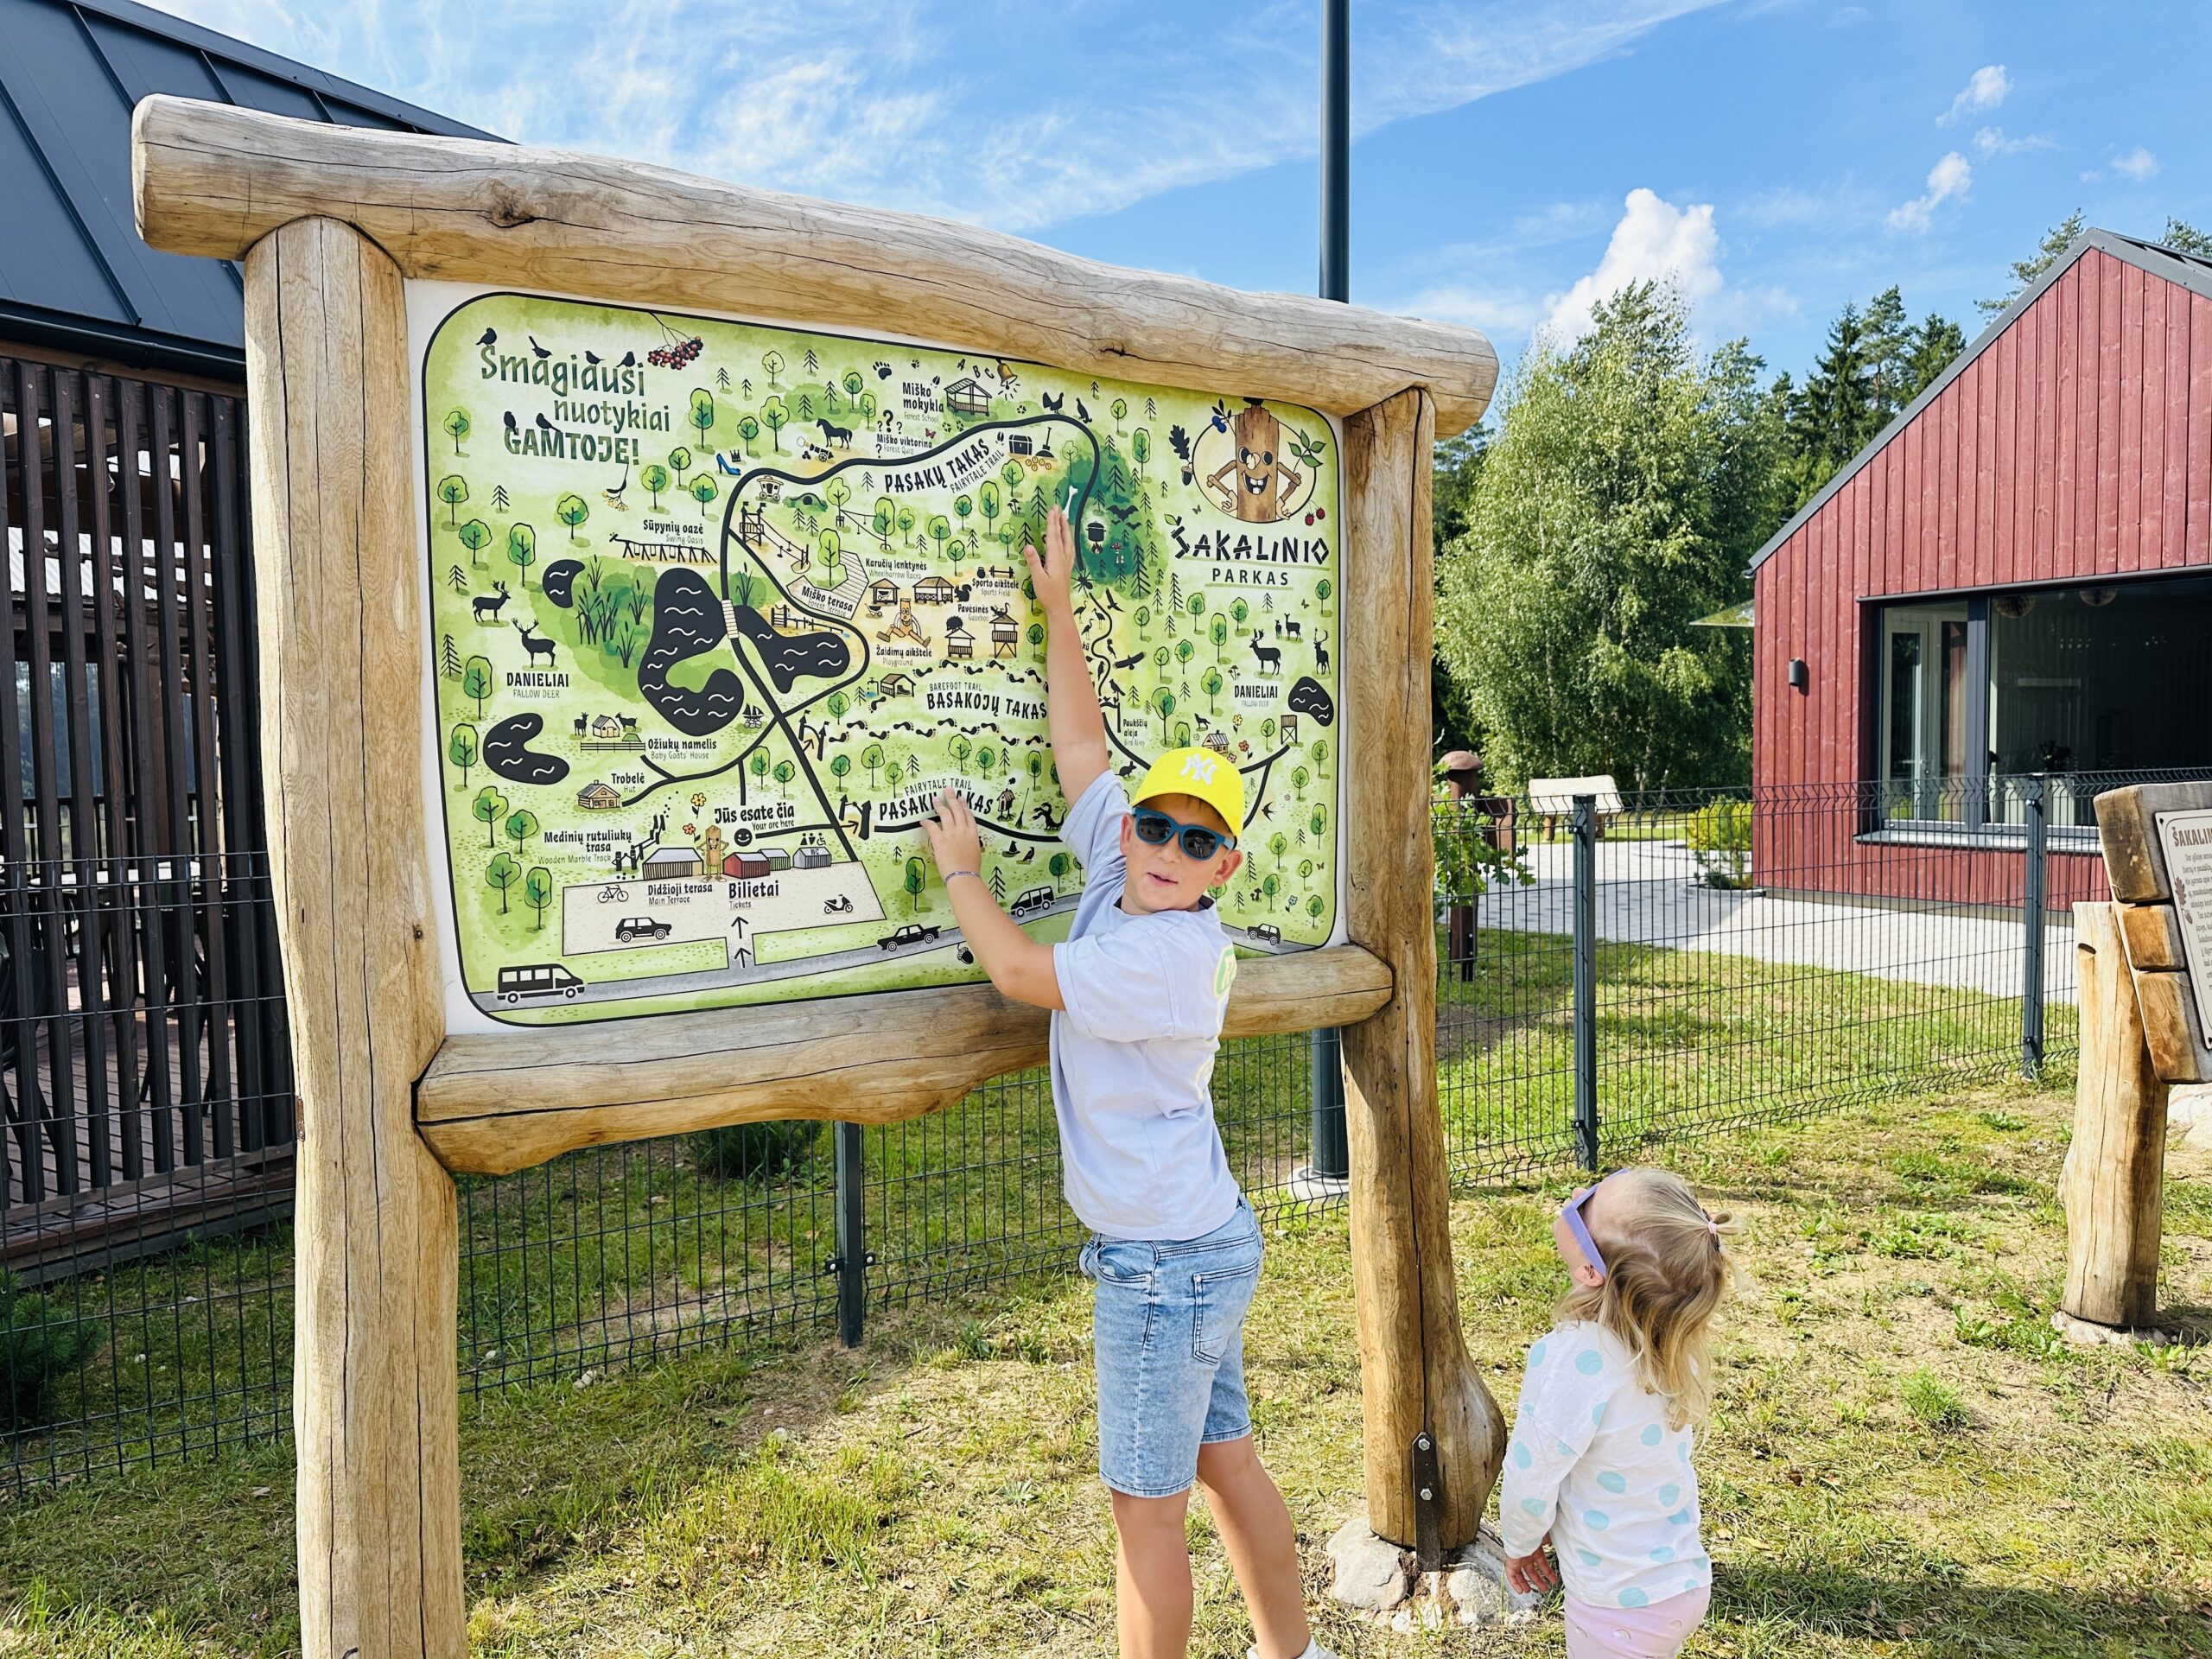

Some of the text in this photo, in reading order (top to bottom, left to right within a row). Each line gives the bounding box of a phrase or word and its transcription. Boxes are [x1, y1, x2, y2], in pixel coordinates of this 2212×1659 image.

[480, 345, 645, 397] Smagiausi
[957, 358, 995, 379] A B C
[902, 381, 931, 397] Miško
[903, 397, 944, 414] mokykla
[554, 399, 671, 434] nuotykiai
[904, 411, 939, 423] Forest School
[504, 427, 639, 466] GAMTOJE!
[876, 433, 932, 449] Miško viktorina
[884, 437, 990, 493] PASAKŲ TAKAS
[950, 448, 1005, 494] FAIRYTALE TRAIL
[643, 519, 704, 537] Sūpynių oazė
[665, 534, 704, 545] Swing Oasis
[1170, 515, 1330, 565] ŠAKALINIO
[866, 557, 927, 571] Karučių lenktynės
[972, 578, 1020, 589] Sporto aikštelė
[1212, 568, 1288, 586] PARKAS
[801, 586, 854, 612] Miško terasa
[876, 645, 932, 659] Žaidimų aikštelė
[882, 658, 913, 666] Playground
[506, 672, 569, 688] DANIELIAI
[929, 681, 982, 692] BAREFOOT TRAIL
[512, 689, 560, 699] FALLOW DEER
[1234, 685, 1278, 698] DANIELIAI
[926, 691, 1048, 720] BASAKOJŲ TAKAS
[648, 738, 716, 753] Ožiukų namelis
[651, 751, 667, 760] Baby
[690, 751, 709, 760] House
[1179, 753, 1217, 785] NY
[611, 772, 645, 785] Trobelė
[904, 778, 972, 796] FAIRYTALE TRAIL
[714, 802, 795, 824] Jūs esate čia
[752, 818, 795, 831] Your are here
[544, 829, 632, 845] Medinių rutuliukų
[586, 842, 612, 853] trasa
[537, 853, 612, 865] Wooden Marble Track
[648, 882, 713, 897] Didžioji terasa
[728, 880, 779, 899] Bilietai
[648, 895, 690, 906] Main Terrace
[728, 900, 752, 910] Tickets
